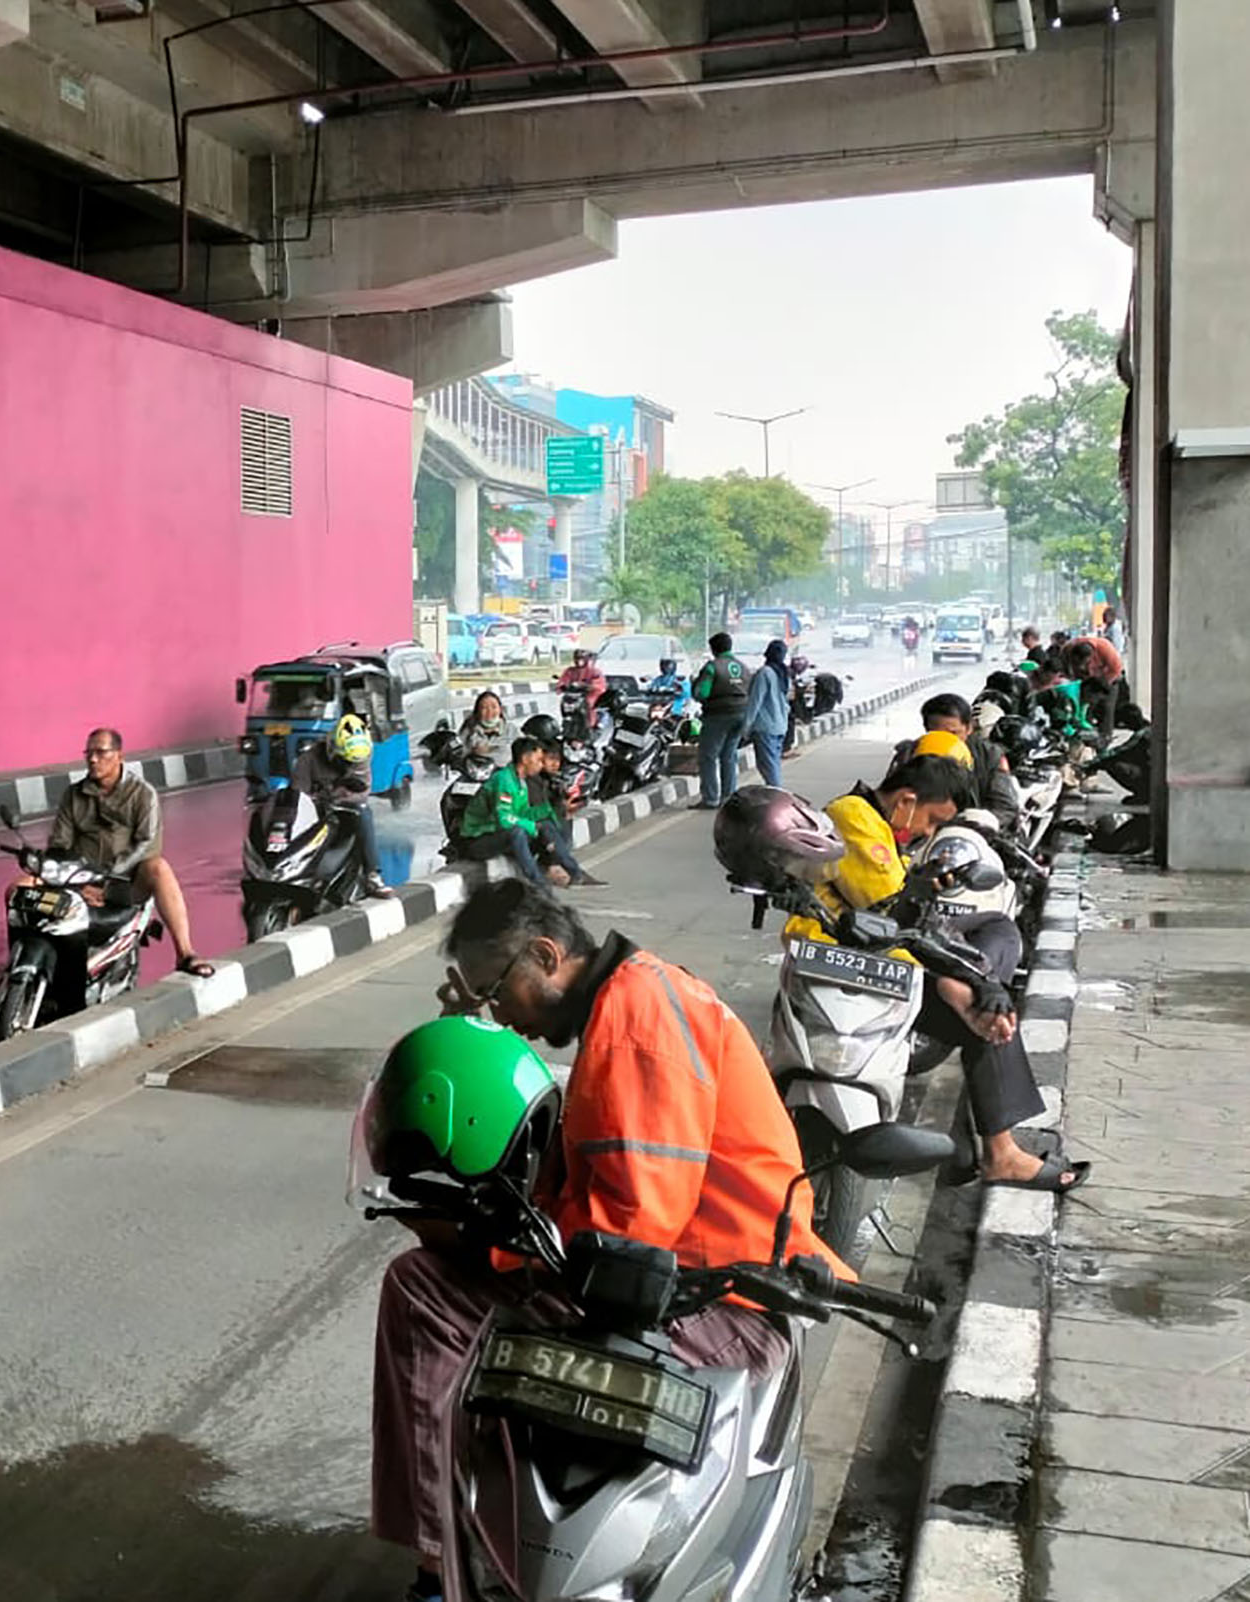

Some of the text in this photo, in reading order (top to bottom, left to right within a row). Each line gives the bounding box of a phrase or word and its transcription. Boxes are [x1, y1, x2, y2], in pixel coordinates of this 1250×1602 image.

[805, 945, 908, 980] B 5523 TAP
[494, 1340, 514, 1367] B
[532, 1347, 614, 1394] 5741
